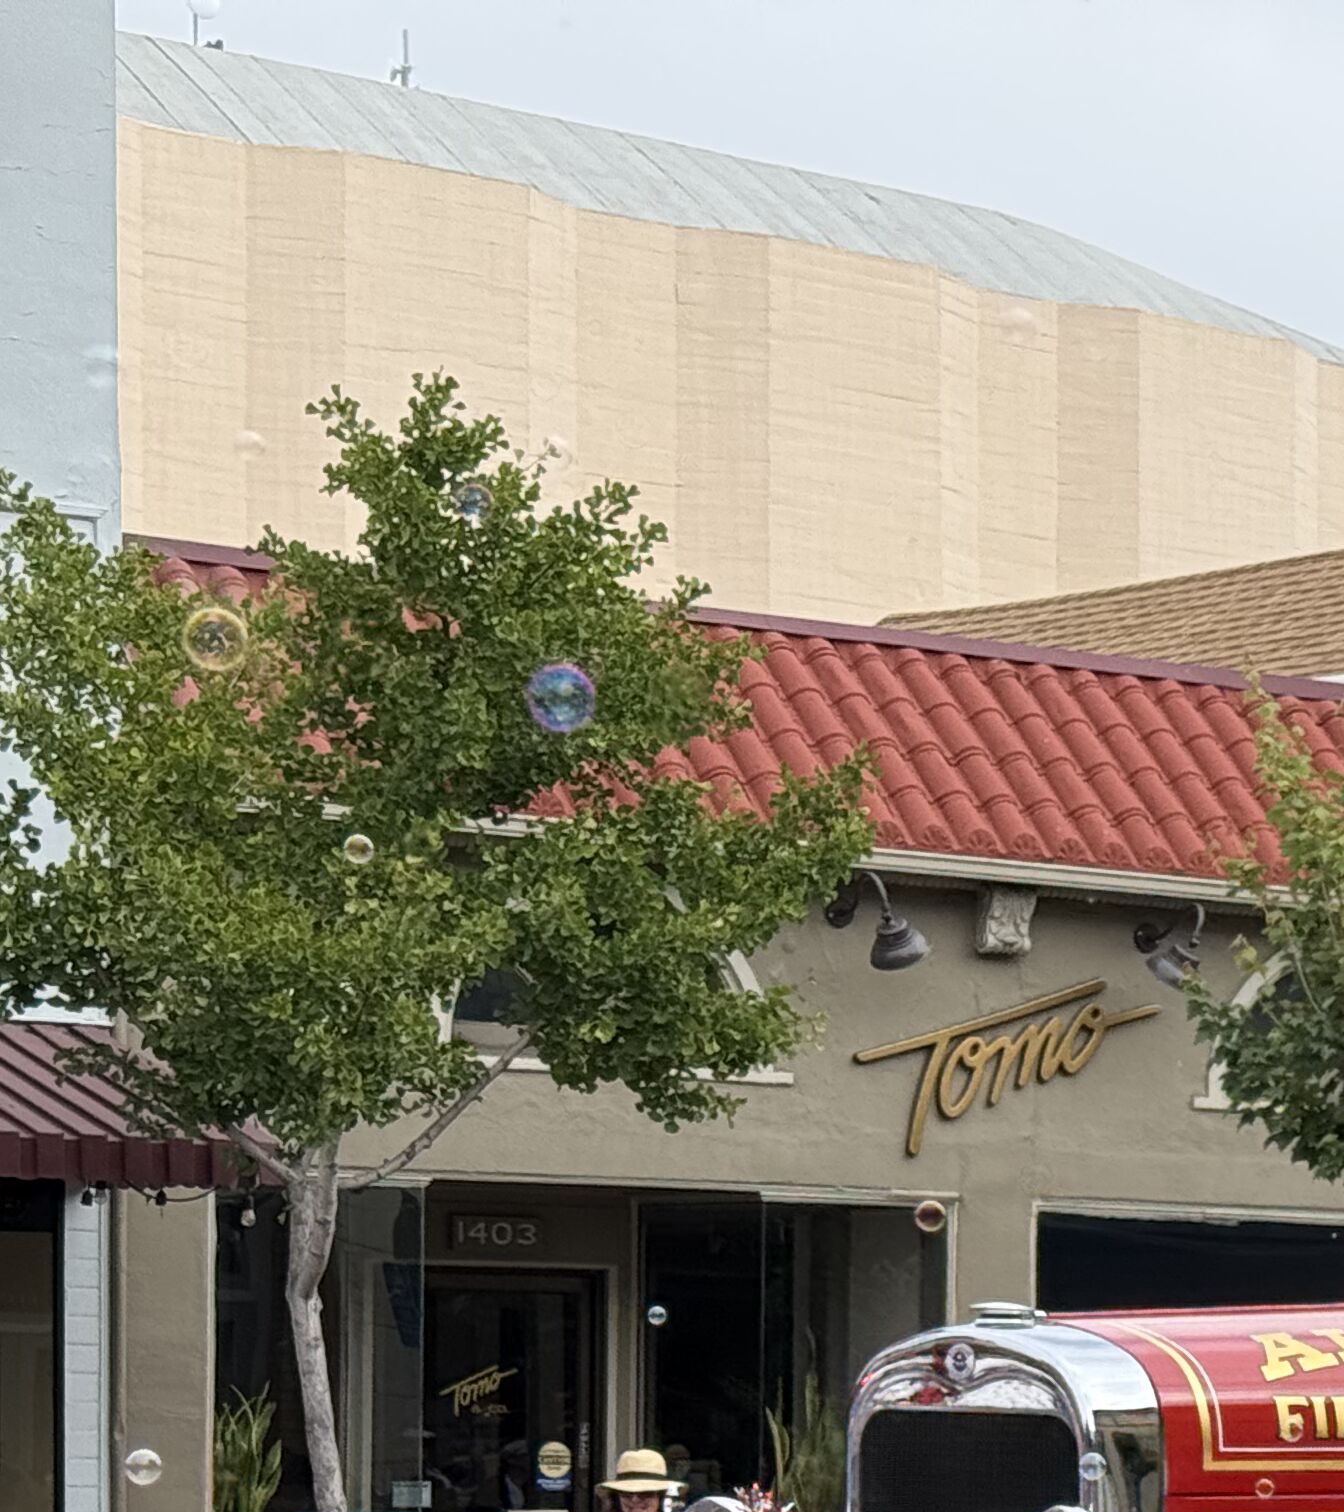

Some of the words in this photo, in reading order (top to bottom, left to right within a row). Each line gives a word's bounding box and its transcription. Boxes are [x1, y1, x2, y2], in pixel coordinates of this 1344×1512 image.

[852, 977, 1162, 1158] Tomo
[457, 1221, 538, 1245] 1403
[438, 1364, 518, 1417] Tomo
